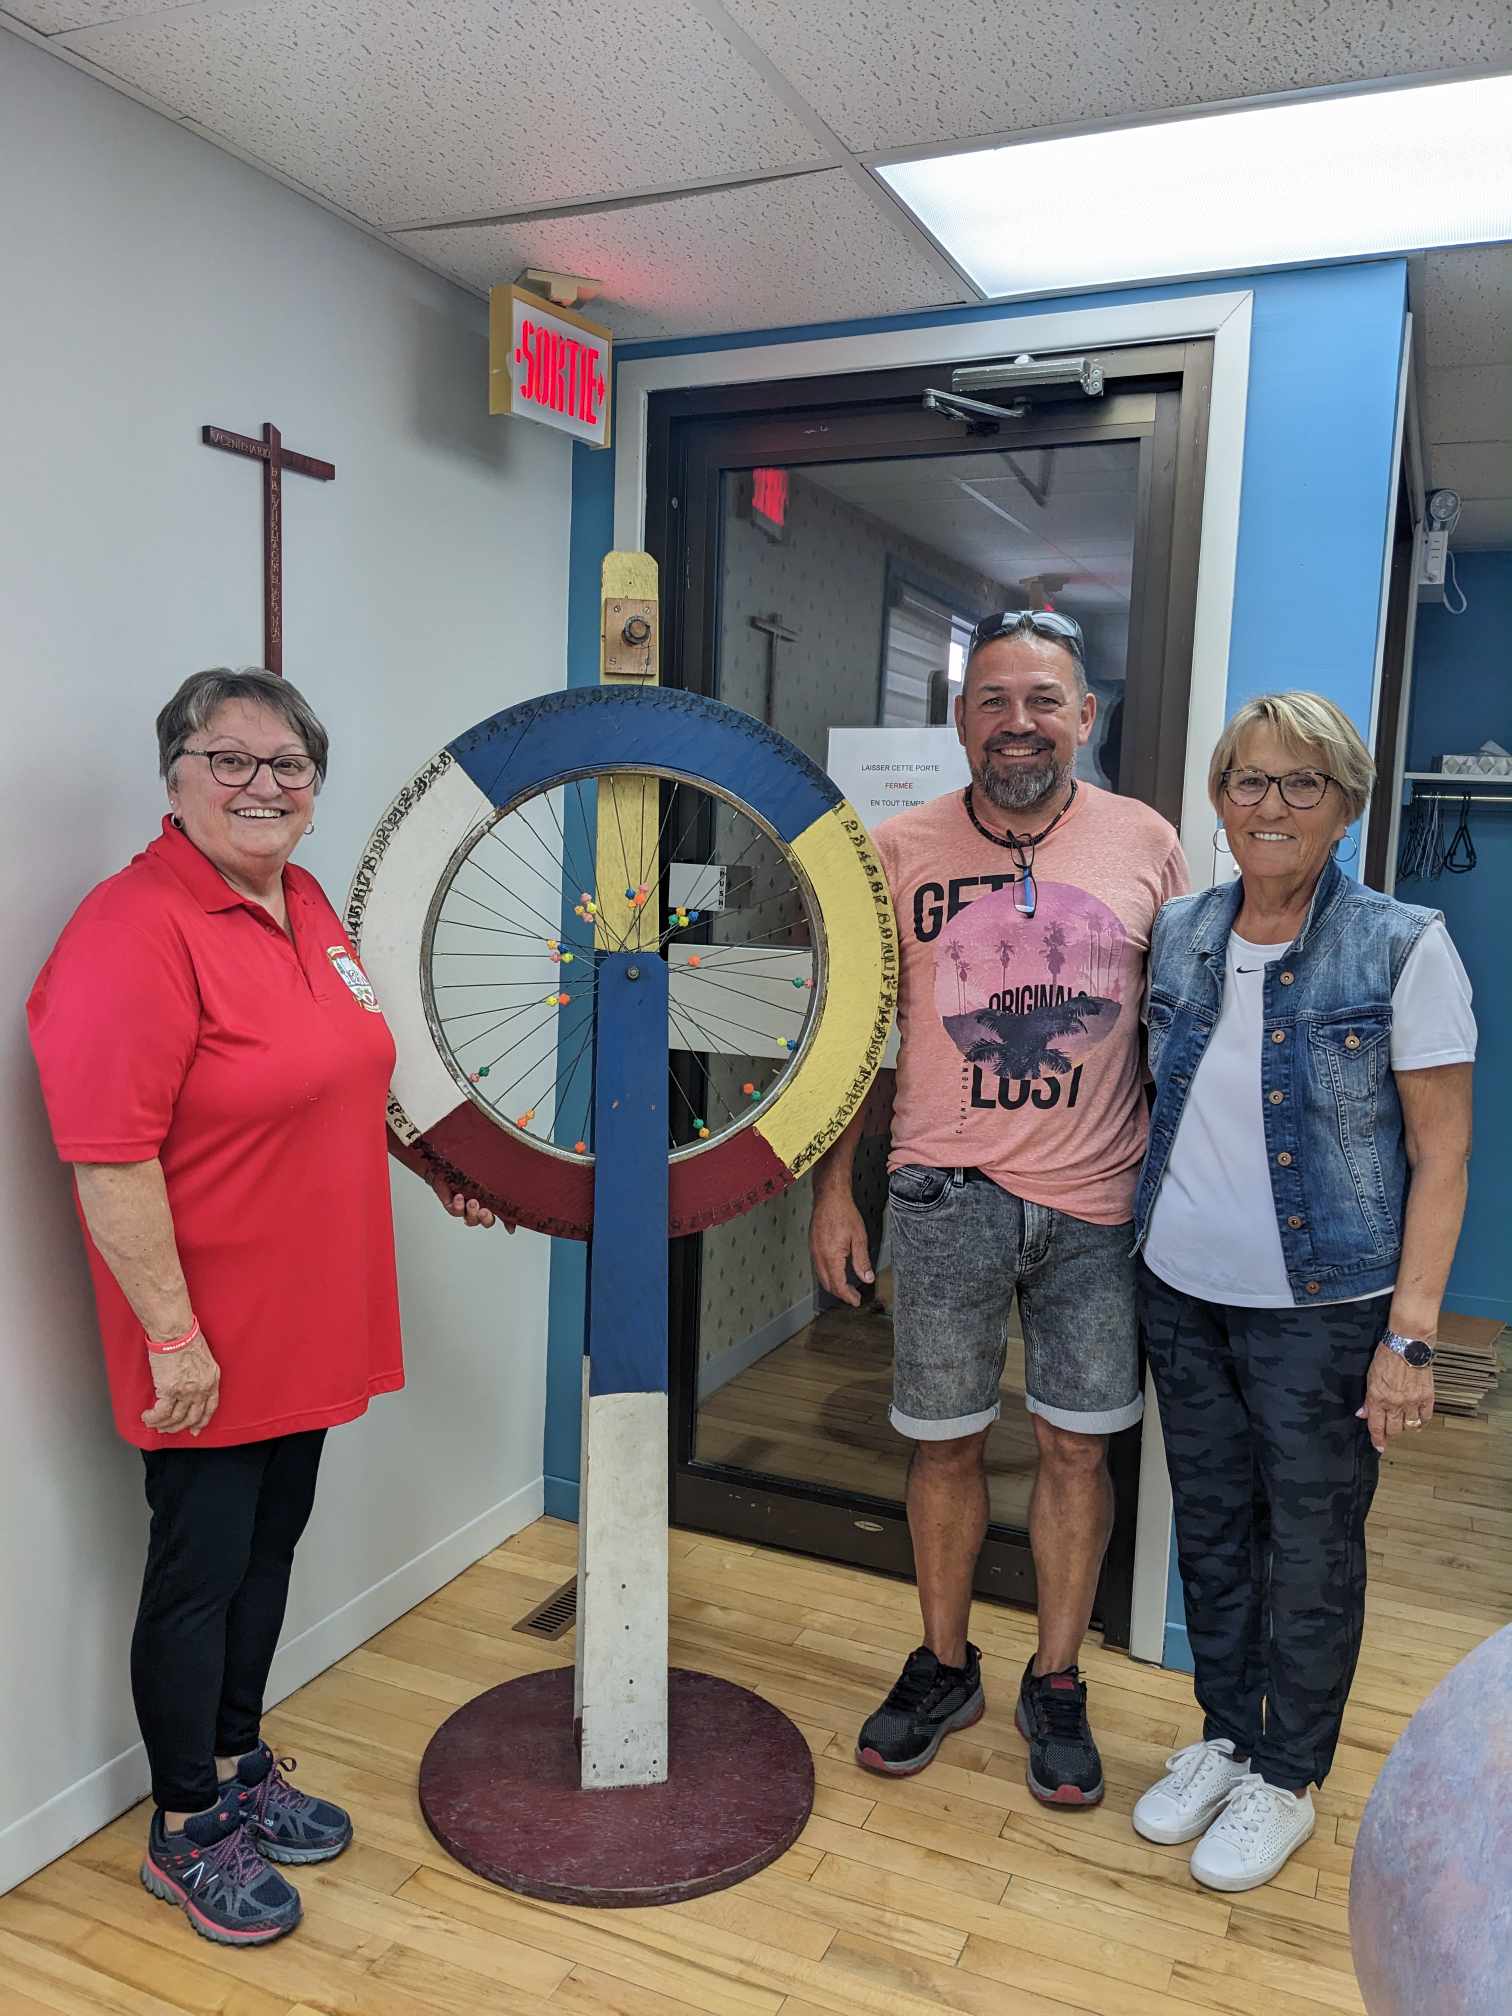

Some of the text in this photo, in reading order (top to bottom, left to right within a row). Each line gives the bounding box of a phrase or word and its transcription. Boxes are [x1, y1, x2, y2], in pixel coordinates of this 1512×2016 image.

[520, 319, 600, 424] SORTIE
[861, 764, 940, 772] LAISSER CETTE PORTE
[870, 799, 880, 807] EN
[882, 799, 900, 807] TOUT
[988, 984, 1088, 1015] ORIGINA
